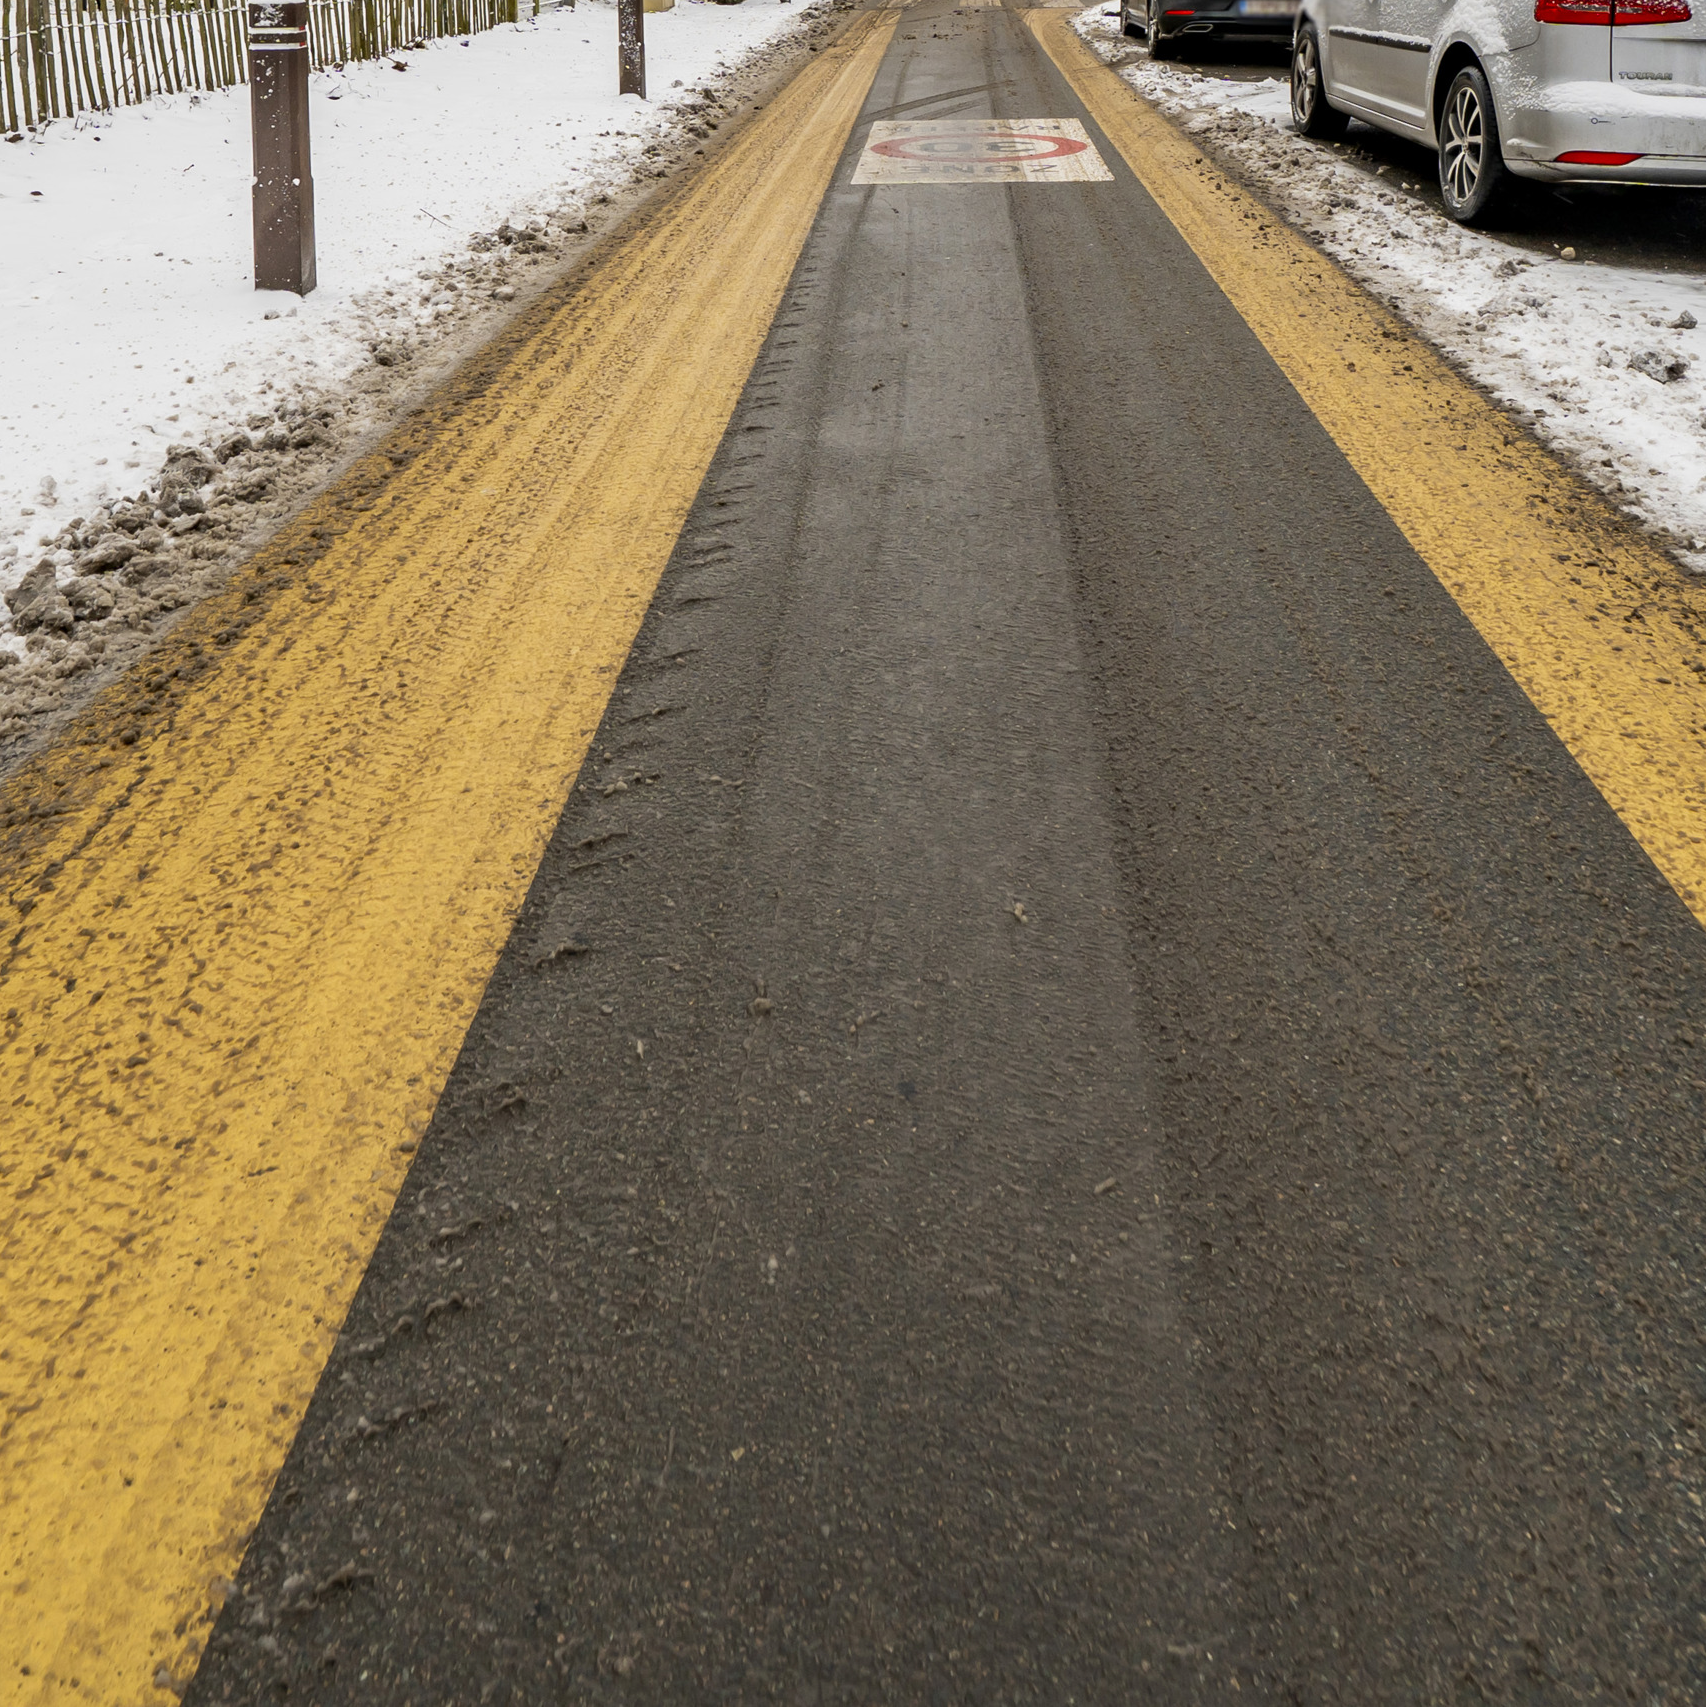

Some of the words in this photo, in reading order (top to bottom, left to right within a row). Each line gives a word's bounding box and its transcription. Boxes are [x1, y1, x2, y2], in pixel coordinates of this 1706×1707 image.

[1619, 71, 1673, 81] TOURAN
[920, 141, 1036, 153] 30
[901, 164, 1061, 174] ZONE
